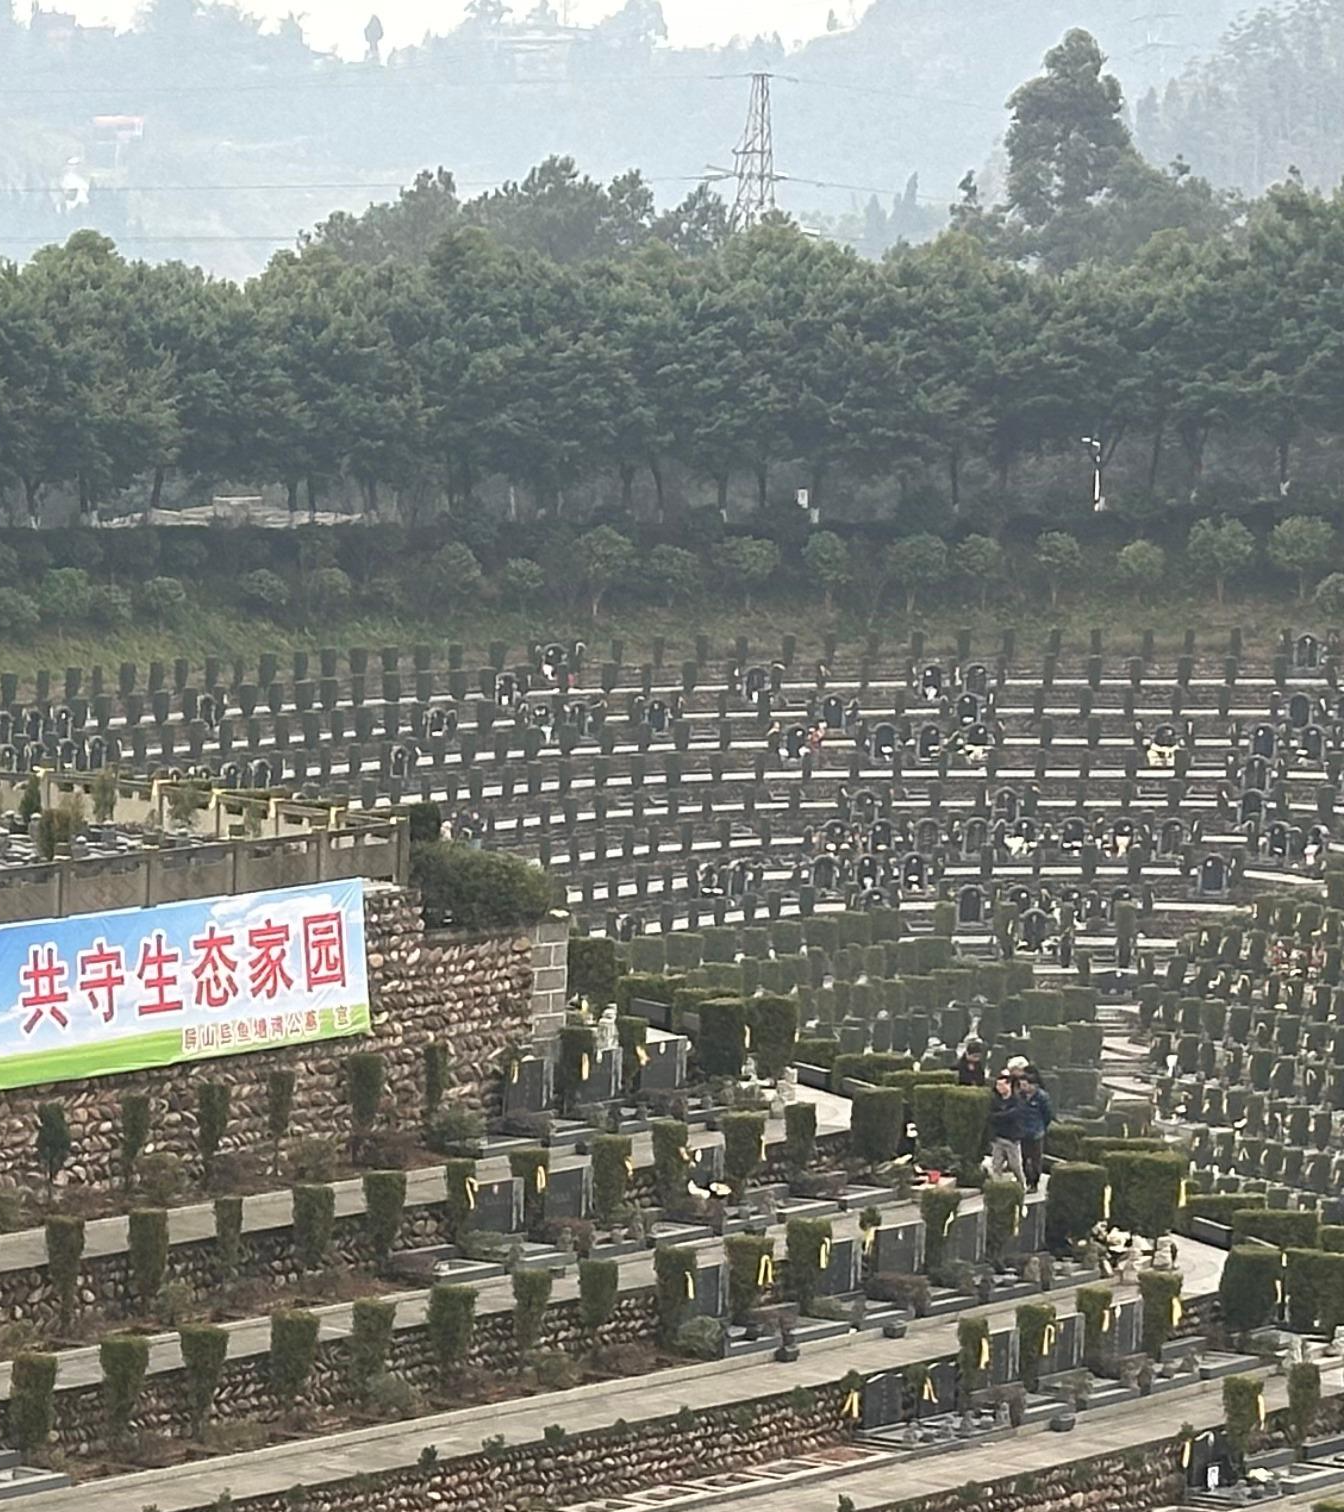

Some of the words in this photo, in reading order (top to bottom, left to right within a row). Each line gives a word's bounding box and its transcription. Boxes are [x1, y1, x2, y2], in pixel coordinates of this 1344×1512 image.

[21, 912, 348, 1030] 共守生态家园
